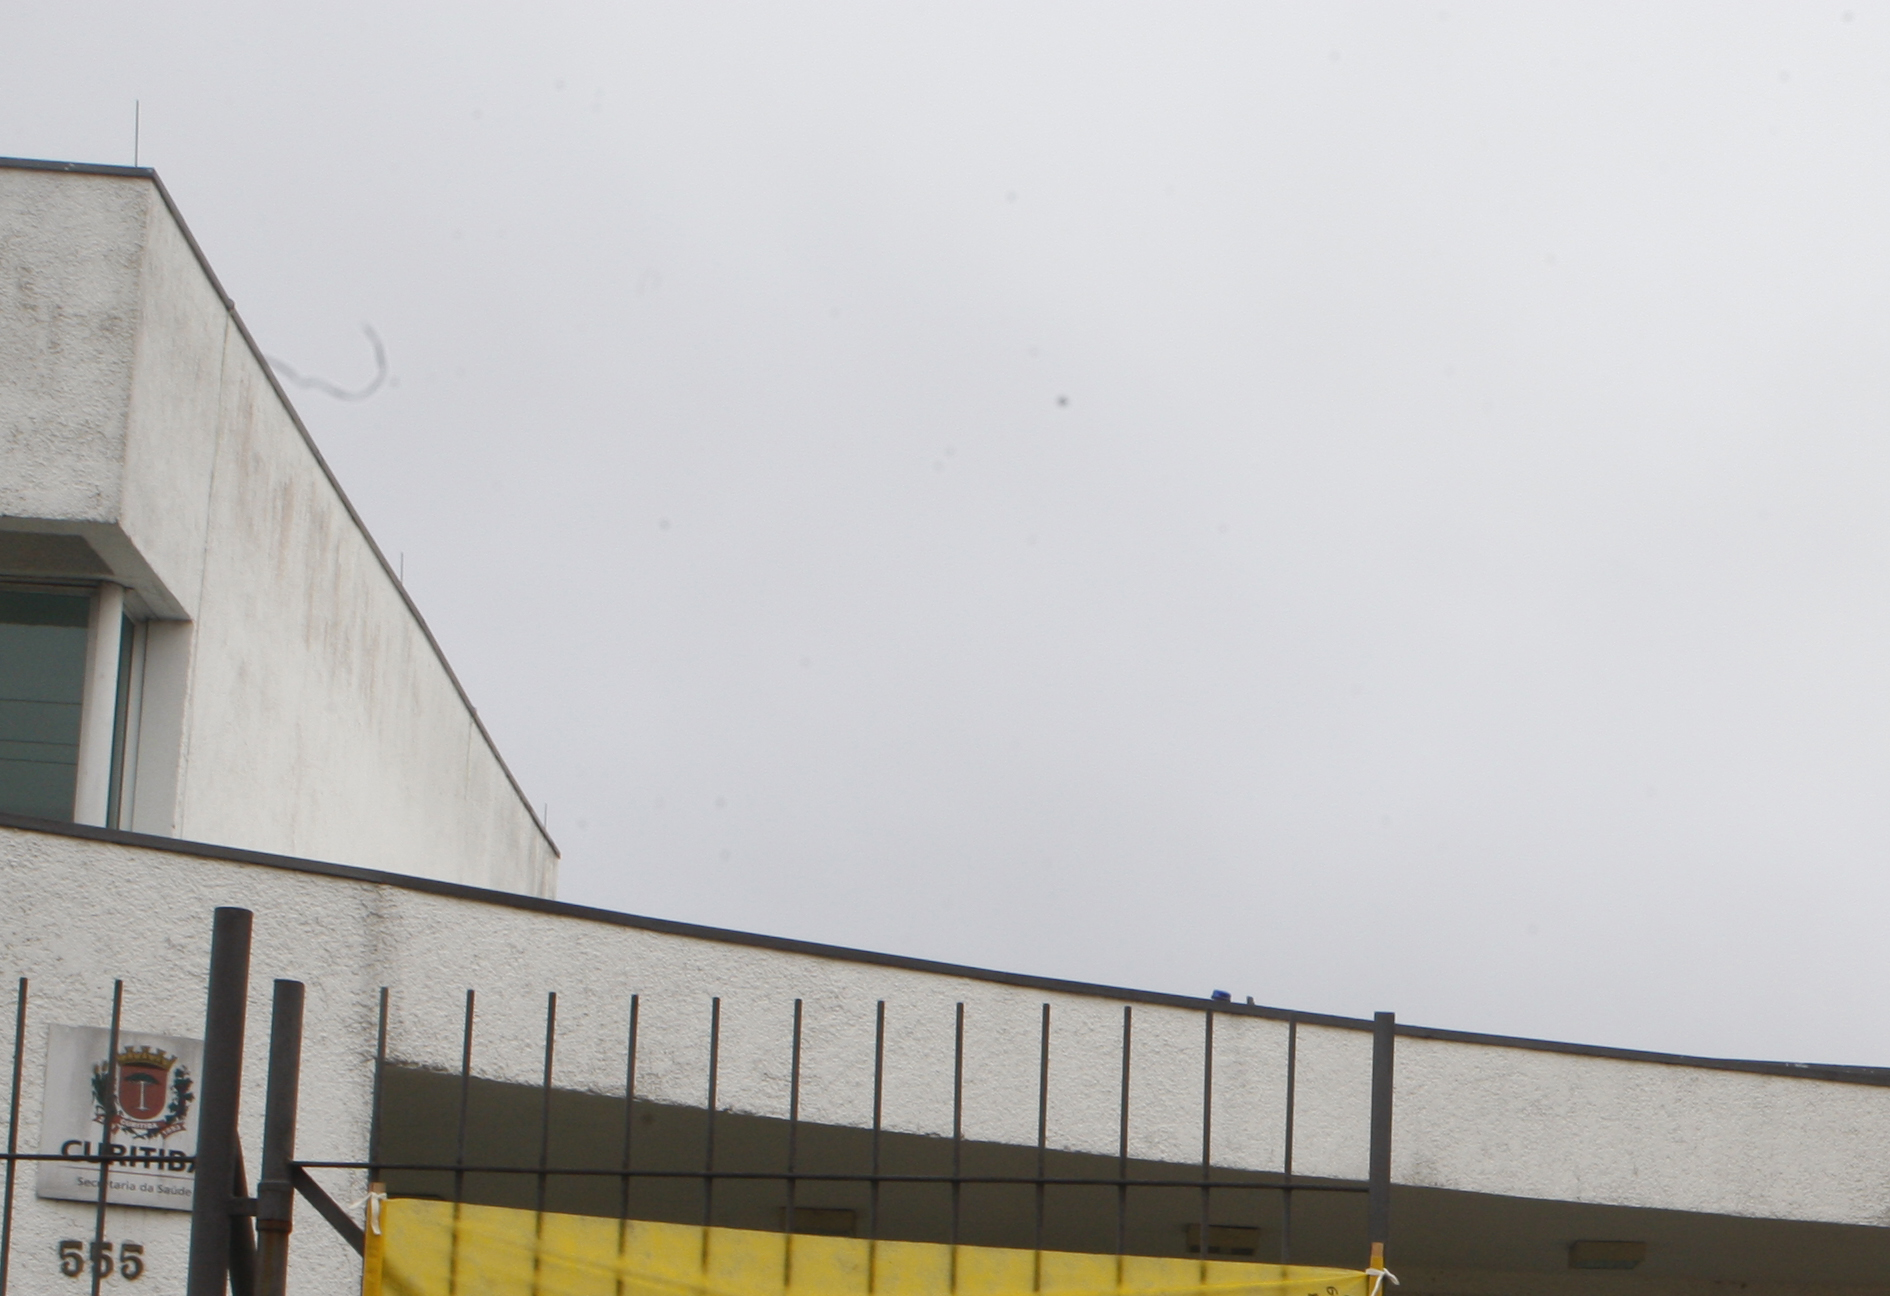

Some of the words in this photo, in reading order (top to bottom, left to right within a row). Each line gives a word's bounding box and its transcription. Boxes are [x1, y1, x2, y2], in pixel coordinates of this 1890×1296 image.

[61, 1139, 196, 1173] CURITIB
[139, 1182, 154, 1193] da
[157, 1184, 192, 1197] Saúde
[59, 1240, 144, 1281] 555
